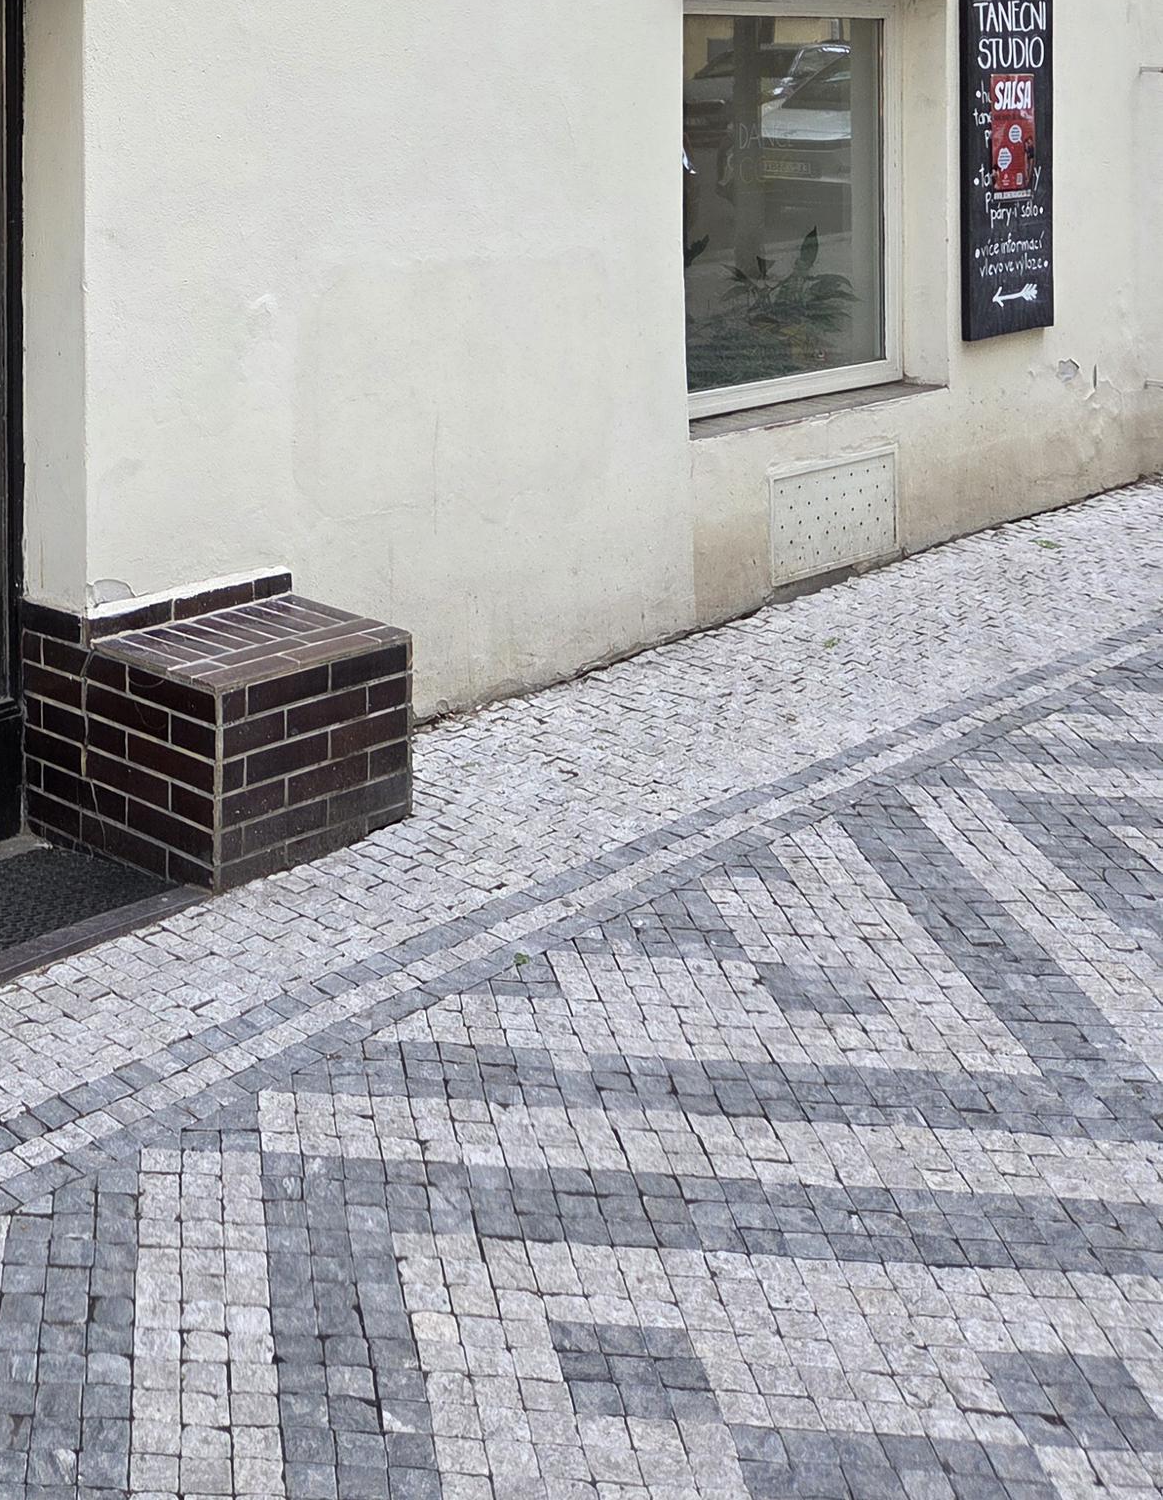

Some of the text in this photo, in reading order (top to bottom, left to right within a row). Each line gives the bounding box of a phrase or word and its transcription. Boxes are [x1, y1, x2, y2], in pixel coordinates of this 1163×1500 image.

[978, 37, 1044, 69] STUDIO
[994, 80, 1031, 111] SALSA
[990, 202, 1012, 229] páry
[1001, 231, 1045, 254] informací
